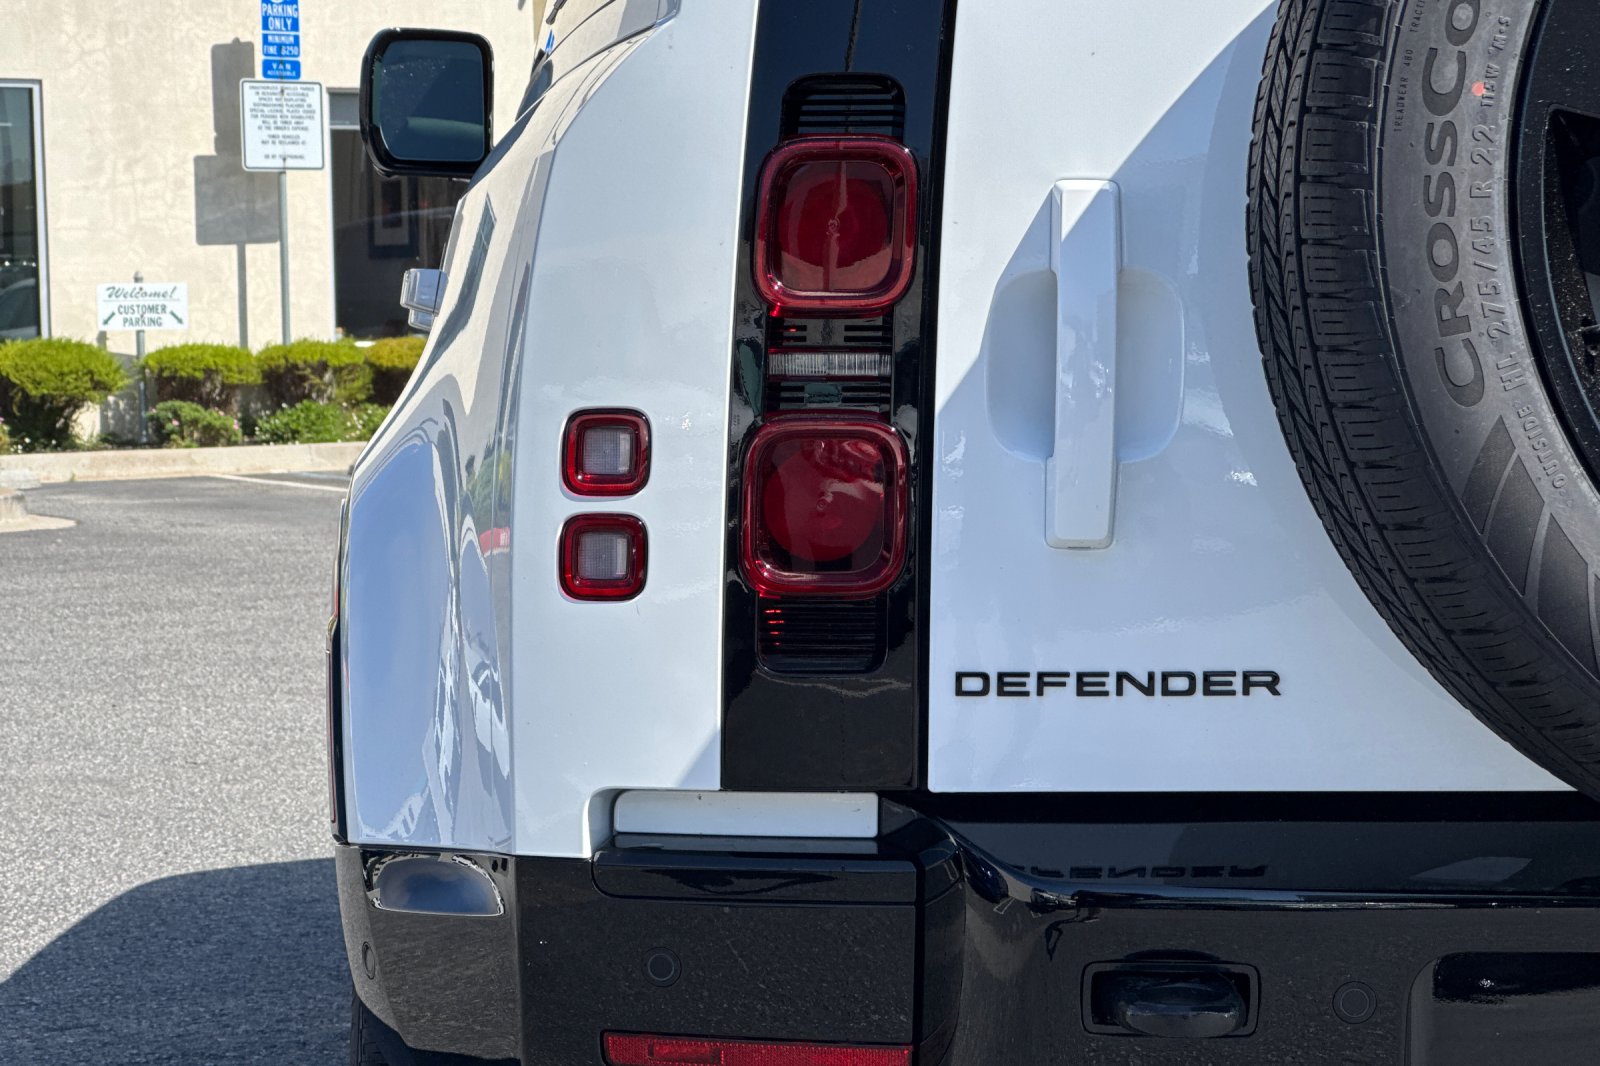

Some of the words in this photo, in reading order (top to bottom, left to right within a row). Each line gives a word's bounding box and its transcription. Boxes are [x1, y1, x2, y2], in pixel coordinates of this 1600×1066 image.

[262, 3, 299, 18] PARKING
[268, 16, 293, 31] ONLY
[271, 62, 292, 70] VAN
[1394, 77, 1409, 132] TREADWEAR
[105, 285, 177, 299] Welcome!
[117, 304, 167, 315] CUSTOMER
[122, 315, 163, 327] PARKING
[1516, 404, 1568, 489] OUTSIDE
[955, 670, 1282, 697] DEFENDER
